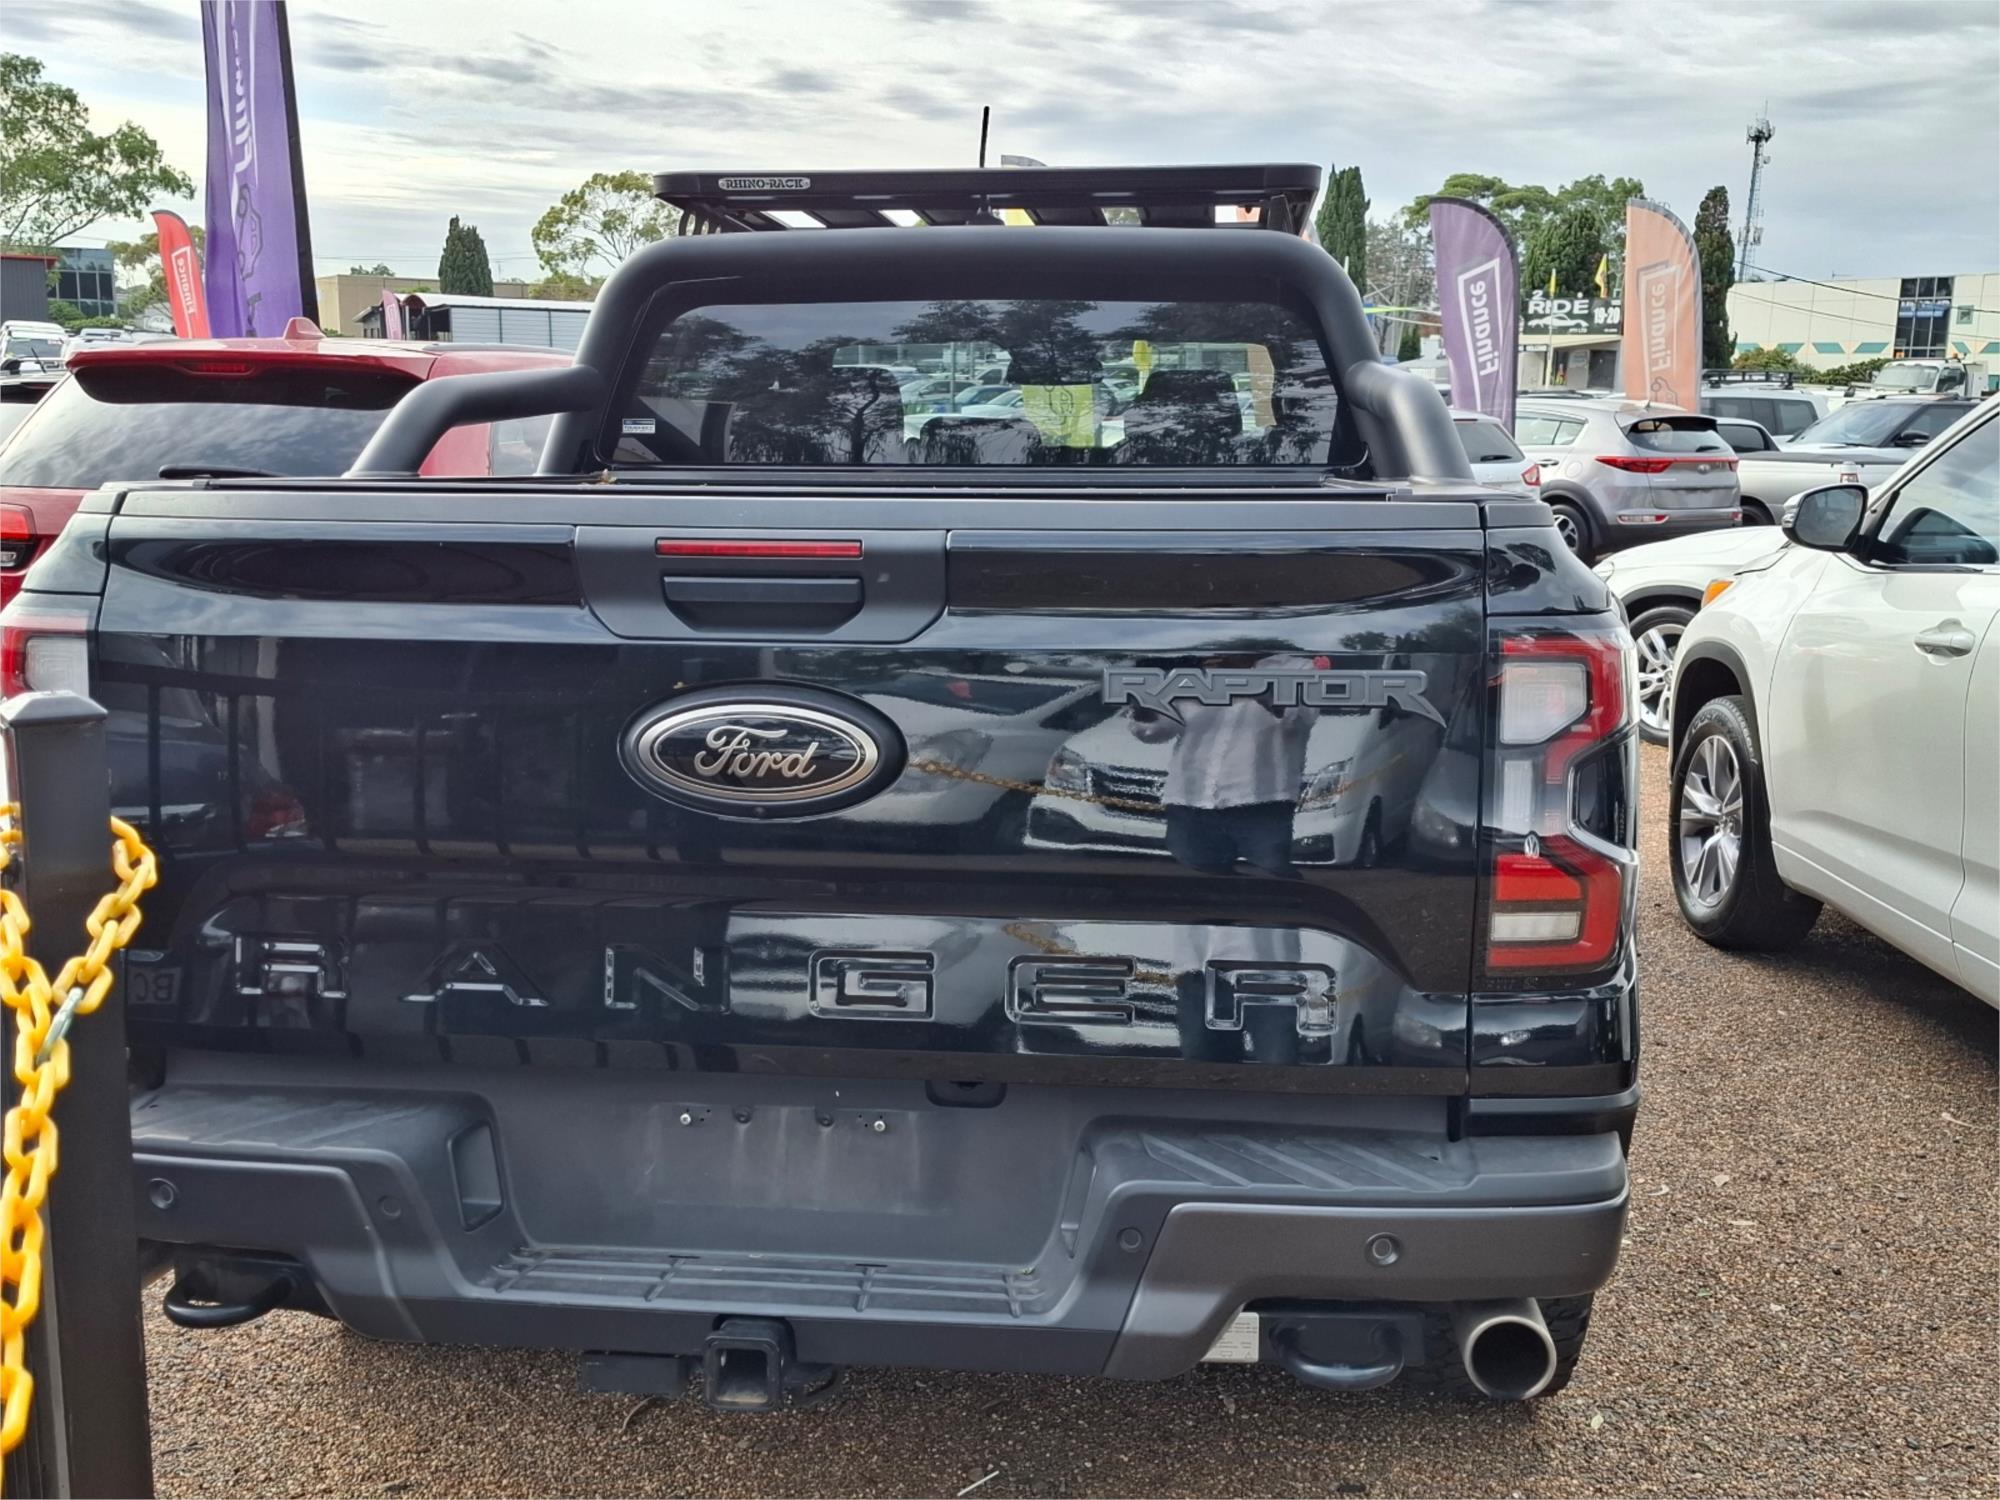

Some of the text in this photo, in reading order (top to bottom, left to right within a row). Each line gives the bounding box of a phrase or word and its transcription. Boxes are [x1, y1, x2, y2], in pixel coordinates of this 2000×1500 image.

[725, 178, 804, 189] RHINO-RACK
[1527, 299, 1590, 315] RIDE
[1102, 667, 1448, 729] RAPTOR
[693, 725, 820, 779] Ford
[233, 931, 1339, 1035] RANGER
